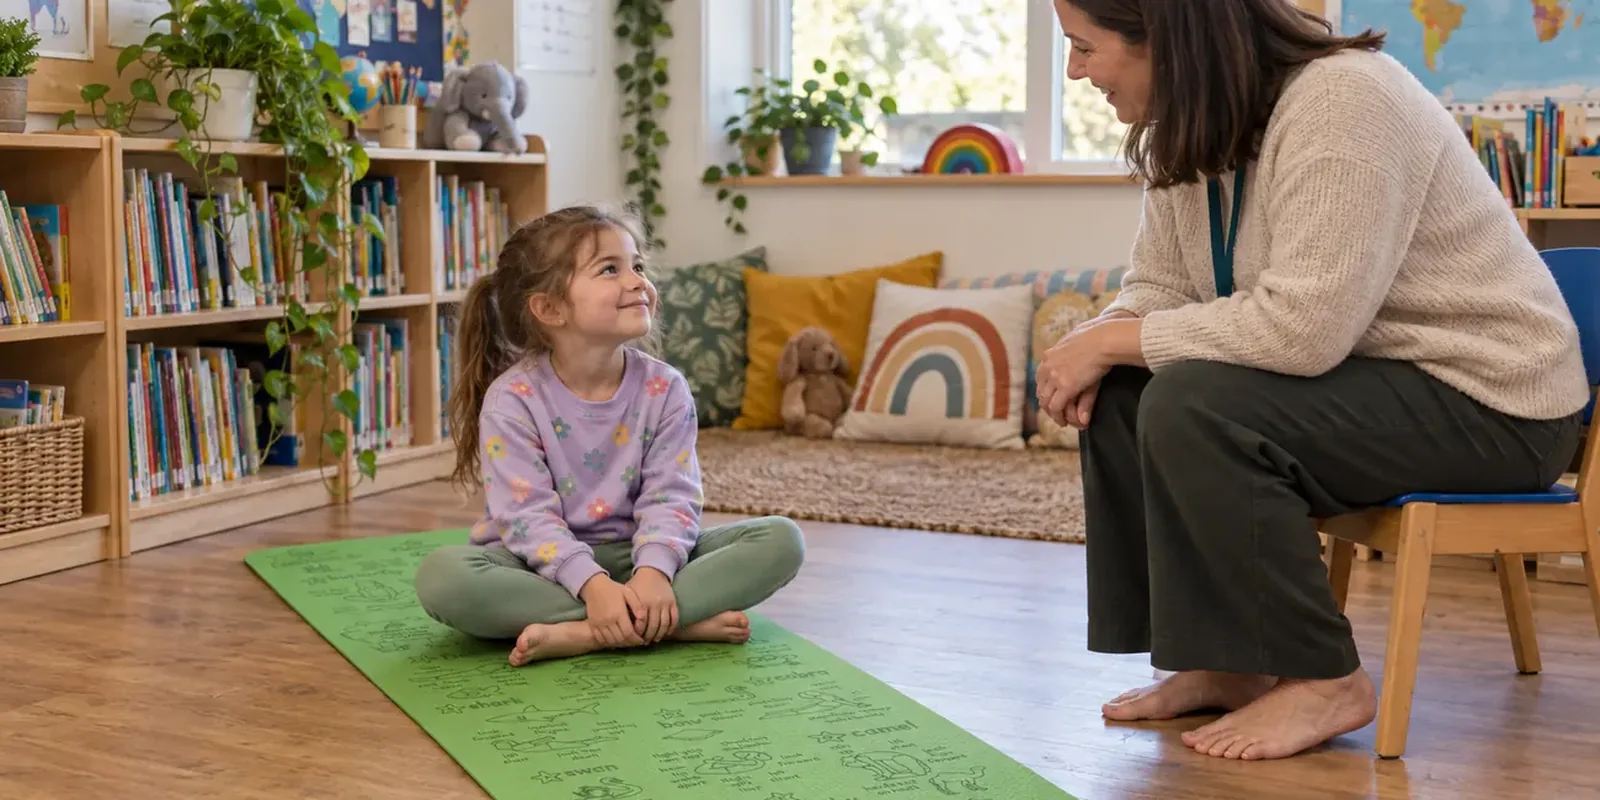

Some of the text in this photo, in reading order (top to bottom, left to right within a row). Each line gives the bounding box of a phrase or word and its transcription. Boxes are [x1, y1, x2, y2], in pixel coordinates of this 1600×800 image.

[468, 697, 524, 710] shark
[851, 720, 918, 738] camel
[563, 763, 619, 778] swan
